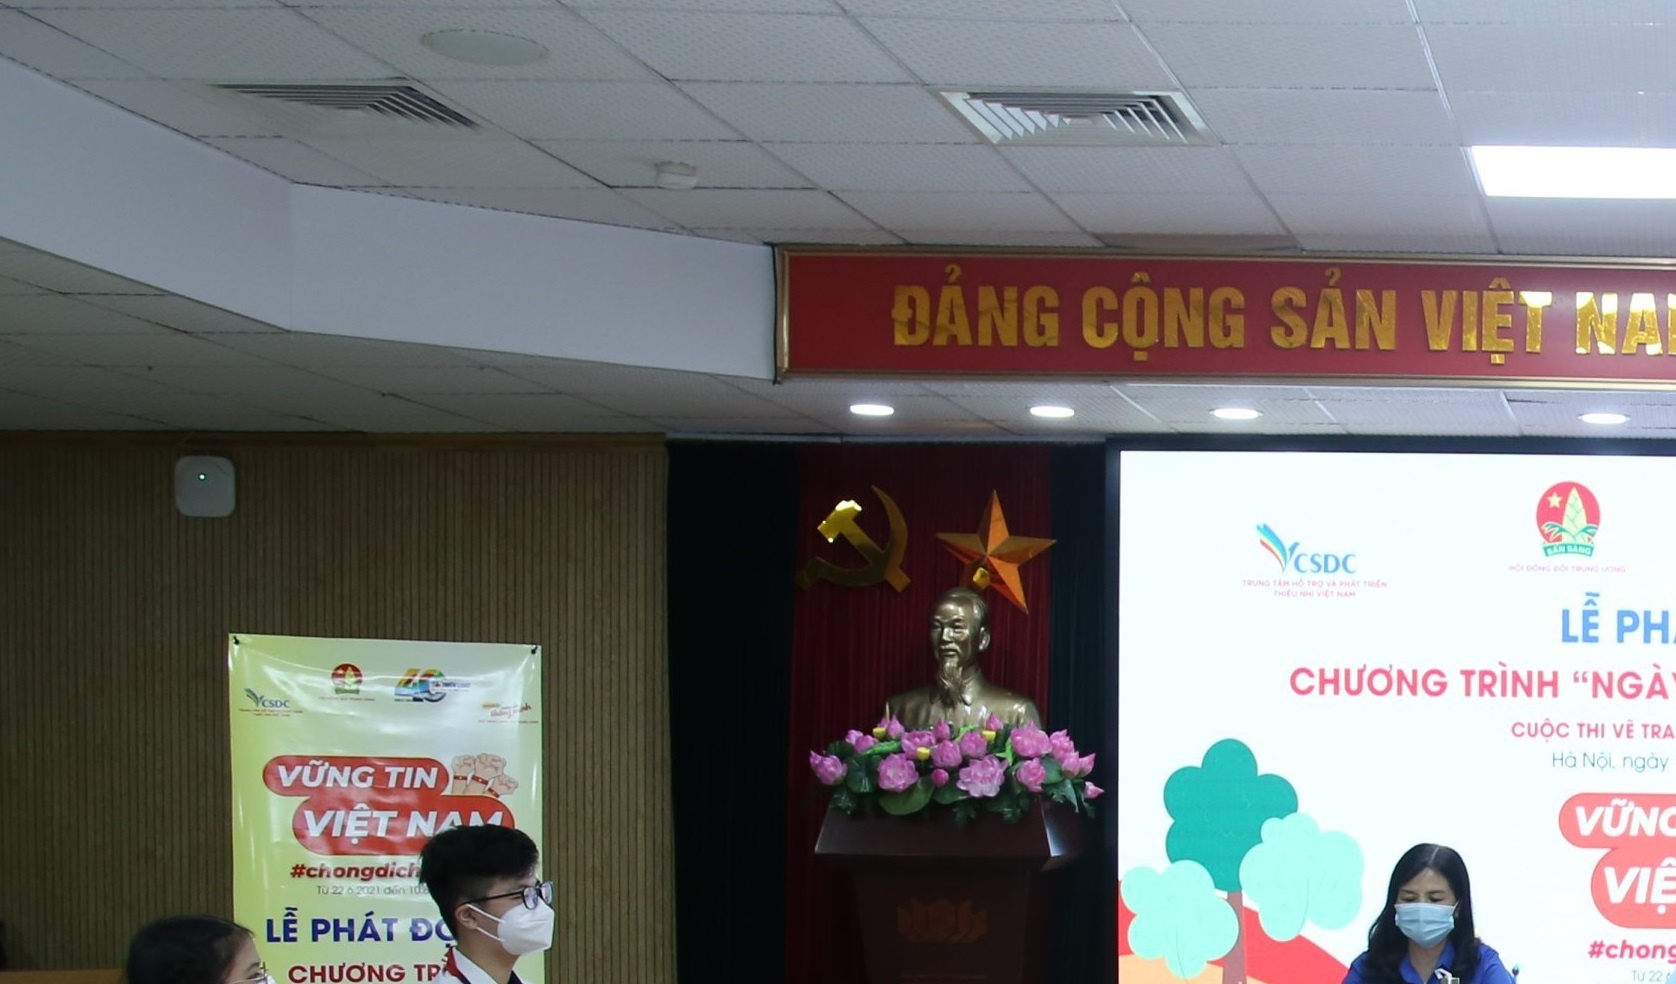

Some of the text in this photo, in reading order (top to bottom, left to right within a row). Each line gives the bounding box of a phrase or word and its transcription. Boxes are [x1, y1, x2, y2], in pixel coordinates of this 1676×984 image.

[891, 264, 1060, 347] ĐẢNG
[1082, 272, 1245, 361] CỘNG
[1271, 268, 1397, 350] SẢN
[1421, 277, 1553, 365] VIỆT
[1562, 592, 1600, 643] LỄ
[1290, 664, 1448, 697] CHƯƠNG
[1460, 661, 1558, 698] TRÌNH
[1511, 718, 1569, 742] CUỘC
[1577, 723, 1604, 738] THI
[1613, 720, 1634, 739] VẼ
[278, 760, 438, 789] VỮNG TIN
[1553, 752, 1576, 768] Hà
[1623, 753, 1668, 773] ngày
[303, 803, 398, 844] VIỆT
[266, 907, 398, 942] LỄ PHÁT
[288, 962, 406, 983] CHƯƠNG
